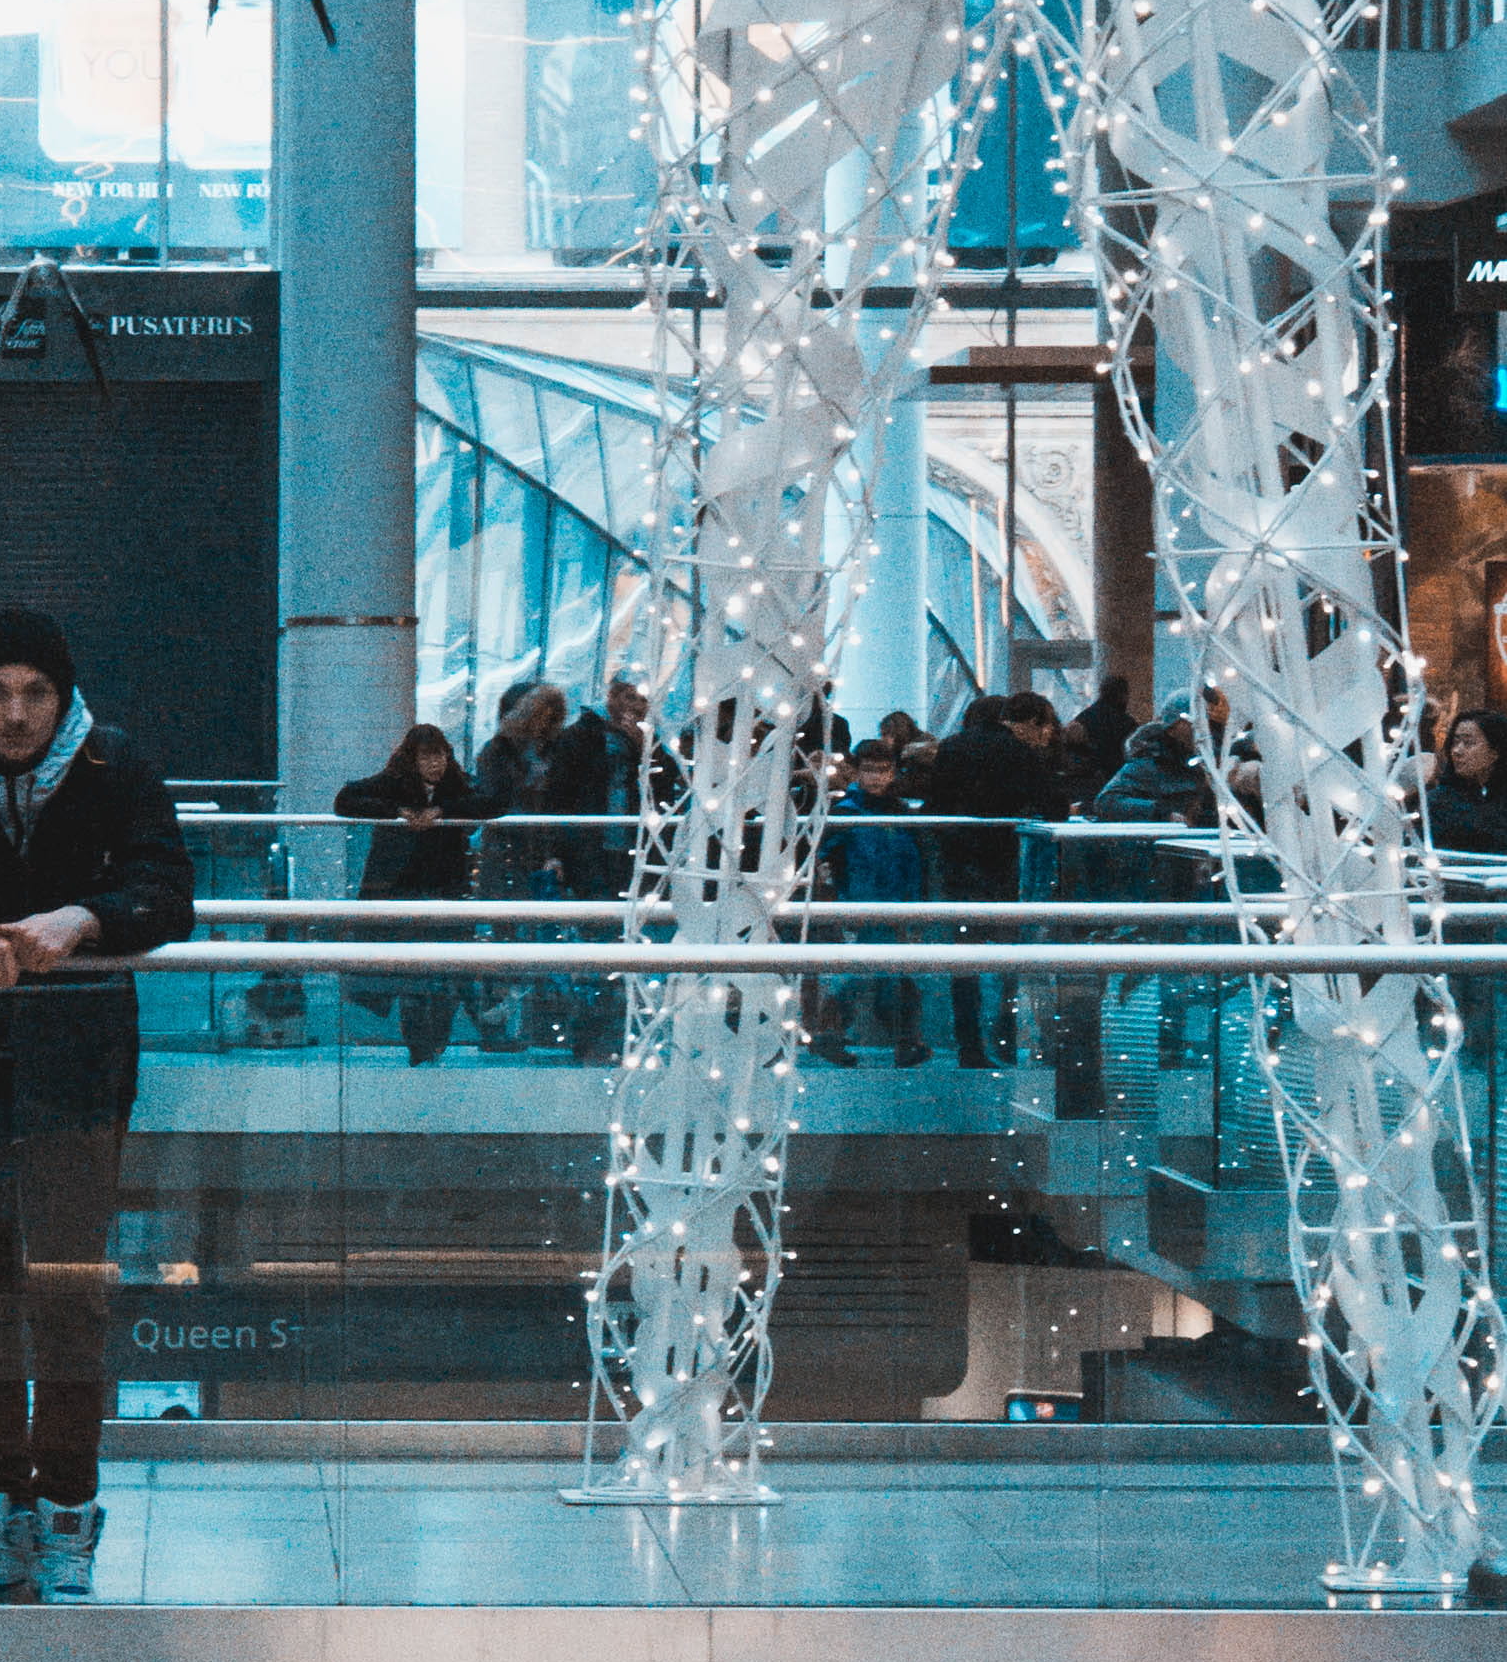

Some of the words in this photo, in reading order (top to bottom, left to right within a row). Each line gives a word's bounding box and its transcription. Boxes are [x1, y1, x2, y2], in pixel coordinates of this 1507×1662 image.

[99, 182, 134, 198] FOR
[199, 183, 241, 198] NEW
[132, 1318, 257, 1353] Queen
